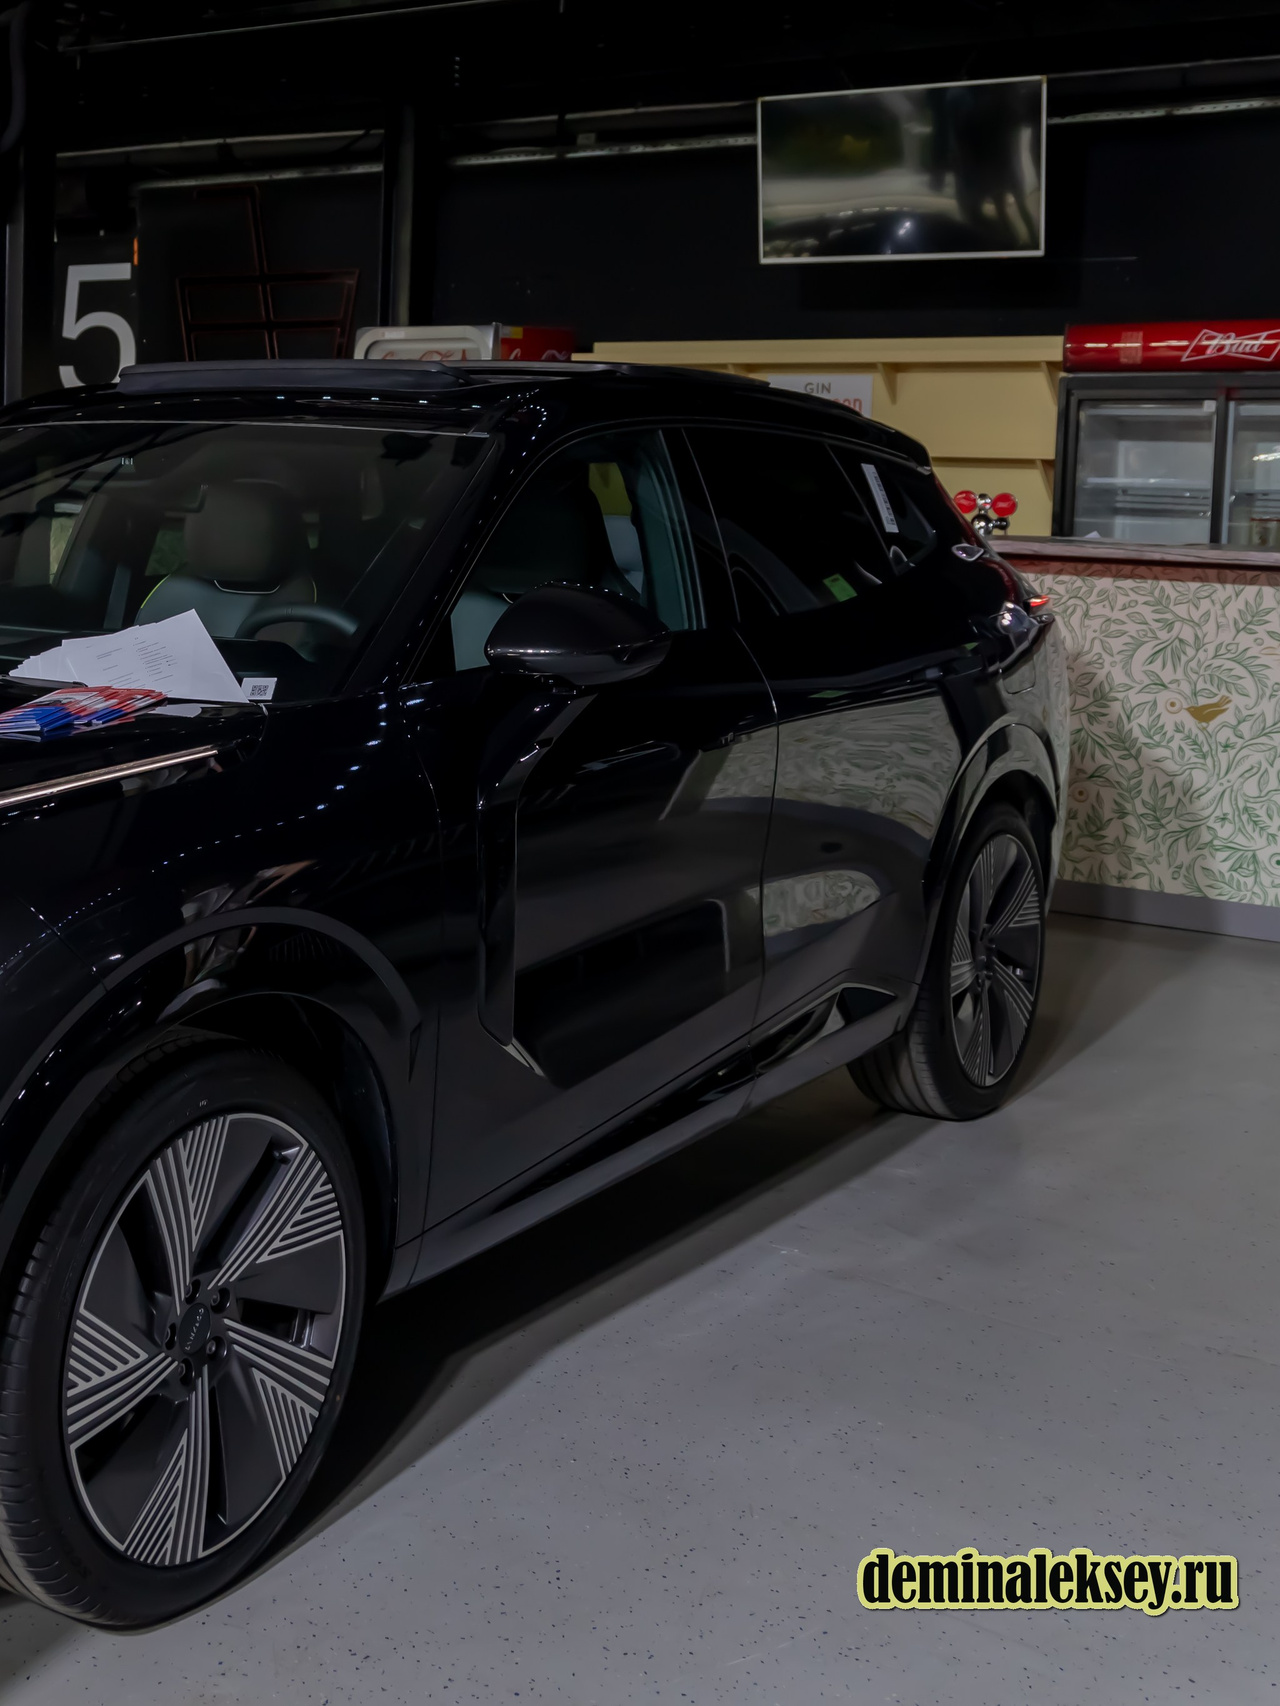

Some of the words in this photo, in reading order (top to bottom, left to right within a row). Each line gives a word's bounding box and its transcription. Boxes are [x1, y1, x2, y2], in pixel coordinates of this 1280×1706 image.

[57, 262, 137, 388] 5
[1201, 332, 1265, 356] Bud
[804, 382, 832, 394] GIN
